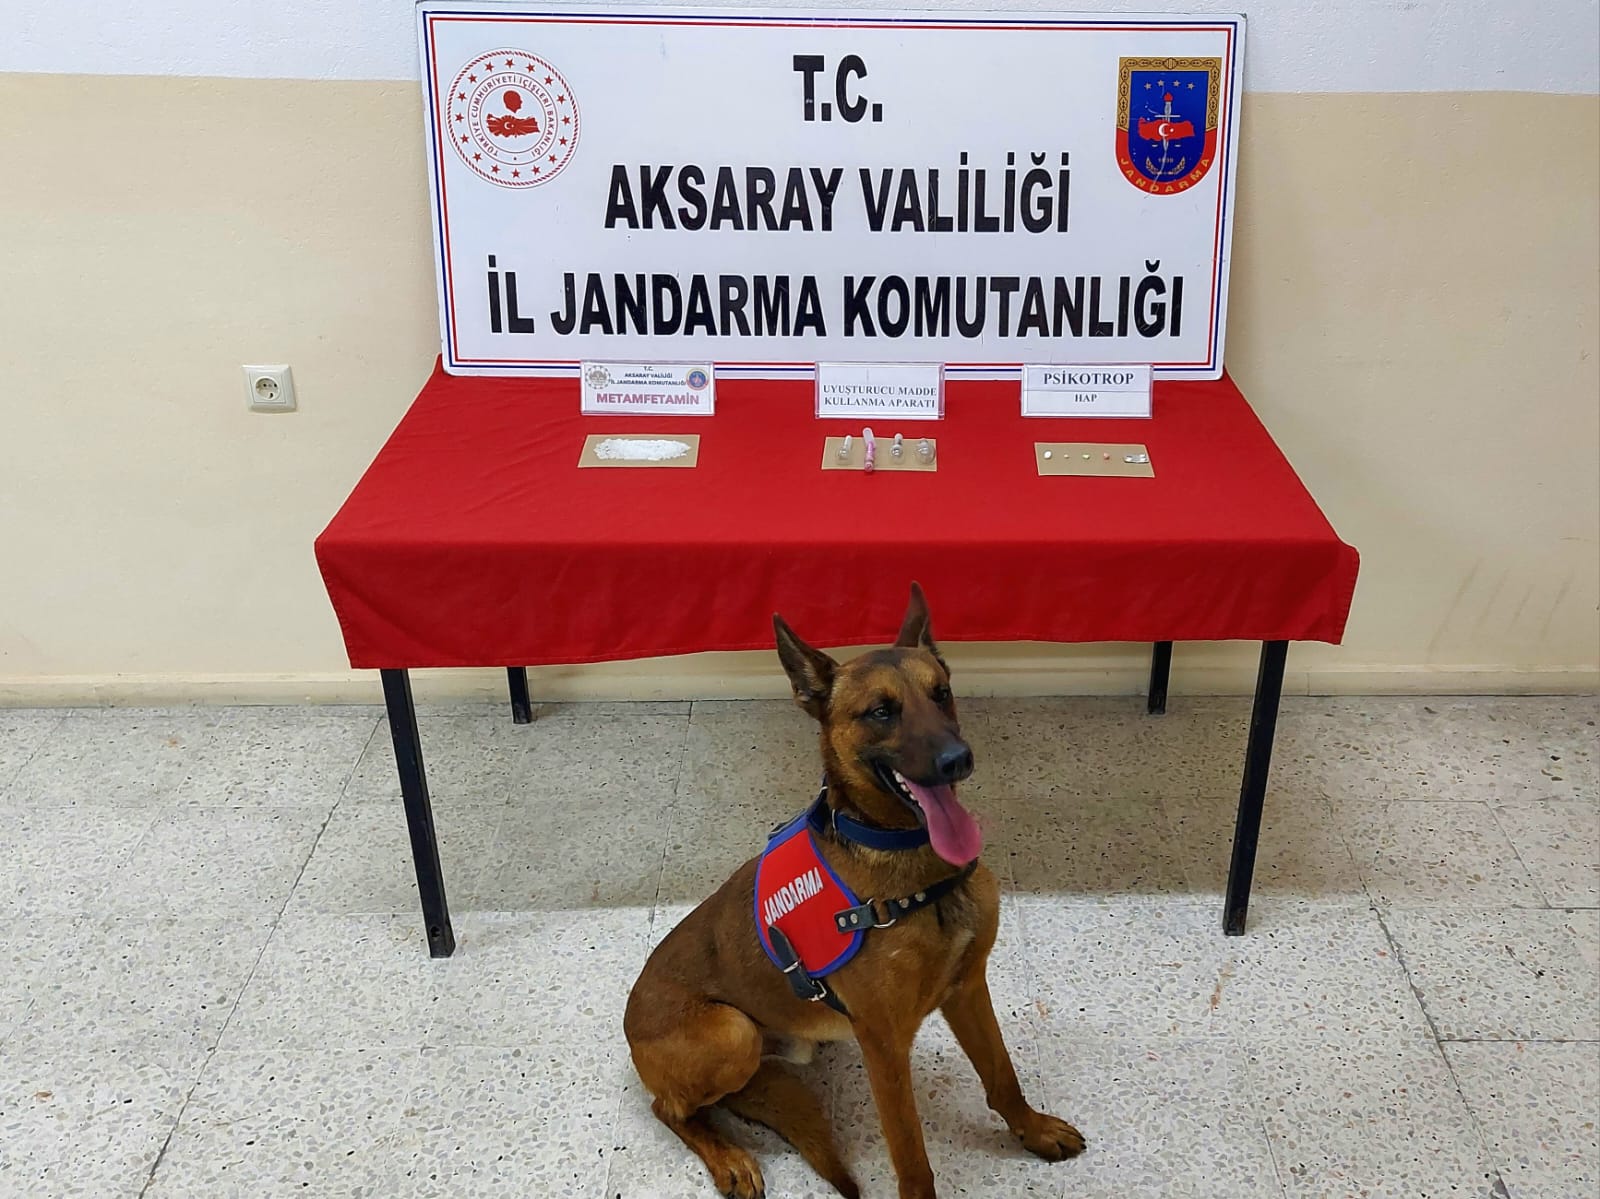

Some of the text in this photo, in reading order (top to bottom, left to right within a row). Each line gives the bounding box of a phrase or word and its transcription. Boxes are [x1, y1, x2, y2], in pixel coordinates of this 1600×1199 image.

[471, 74, 516, 118] CUMHURİYETİ
[519, 76, 553, 110] İÇİŞLERİ
[793, 54, 883, 123] T.C.
[604, 151, 1070, 234] AKSARAY VALİLİĞİ
[1120, 158, 1210, 193] JANDARMA
[487, 254, 1184, 338] İL JANDARMA KOMUTANLIĞI
[823, 385, 937, 396] UYUŞTURUCU MADDE
[1043, 370, 1134, 385] PSİKOTROP
[596, 392, 699, 405] METAMFETAMİN
[824, 397, 935, 408] KULLANMA APARATI
[1075, 393, 1098, 402] HAP
[764, 866, 824, 926] JANDARMA
